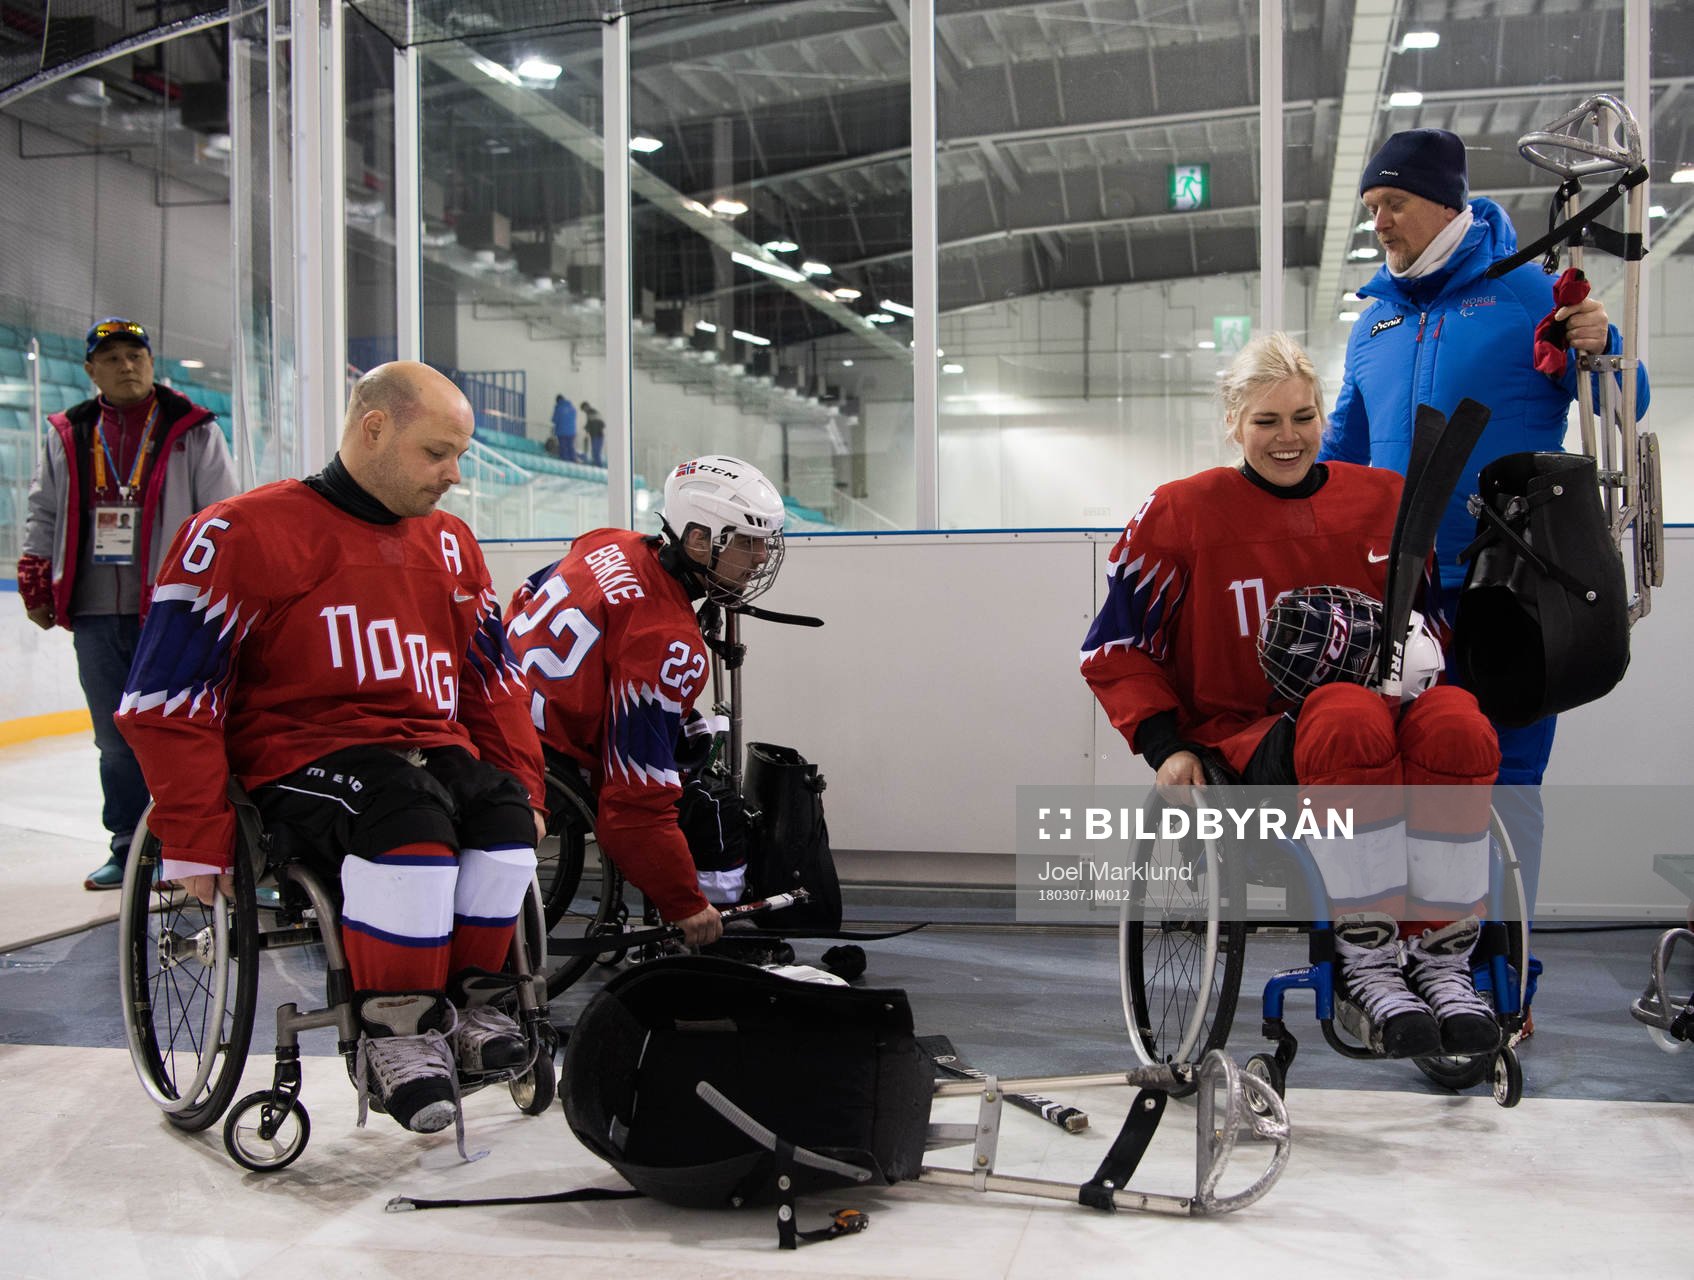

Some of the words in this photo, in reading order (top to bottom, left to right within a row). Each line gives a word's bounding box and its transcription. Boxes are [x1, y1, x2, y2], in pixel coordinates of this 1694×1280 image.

[1461, 296, 1497, 306] NORGE
[698, 464, 740, 480] CCM
[440, 530, 463, 576] A
[574, 543, 645, 605] BAKKE
[660, 640, 706, 698] 22
